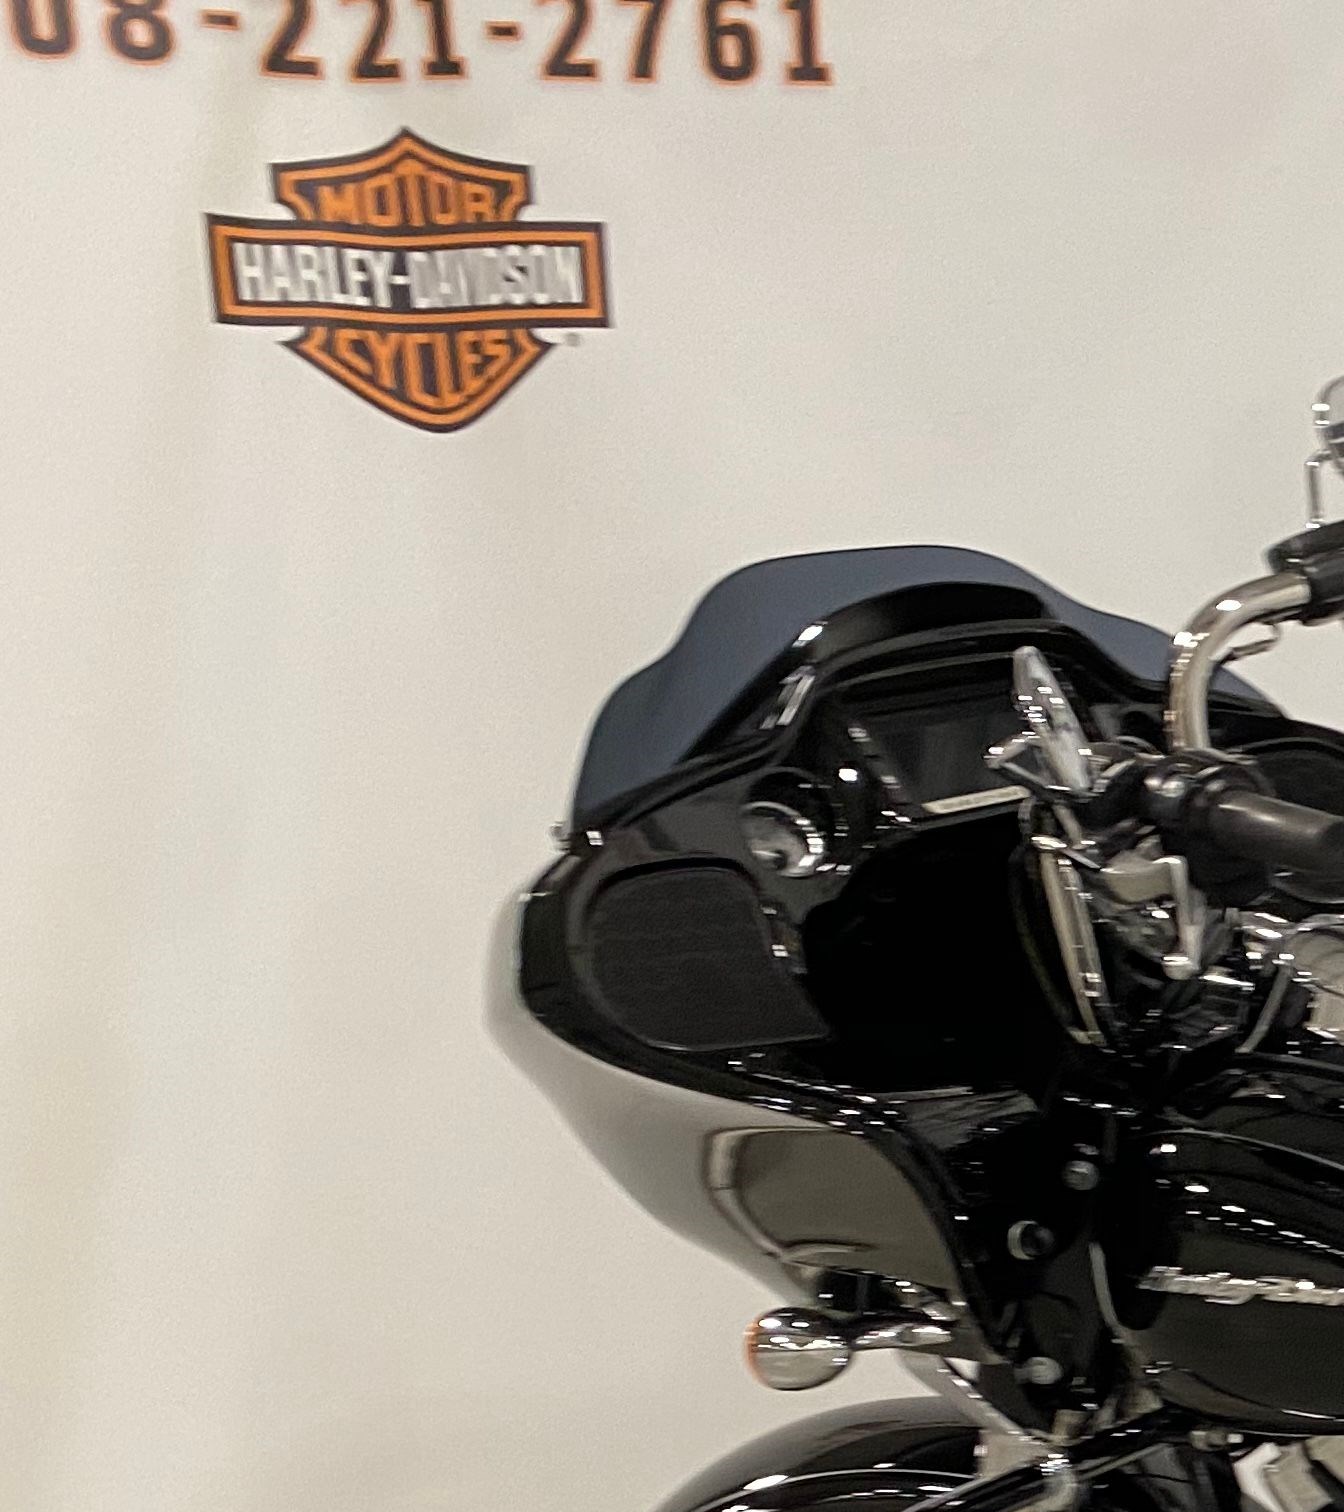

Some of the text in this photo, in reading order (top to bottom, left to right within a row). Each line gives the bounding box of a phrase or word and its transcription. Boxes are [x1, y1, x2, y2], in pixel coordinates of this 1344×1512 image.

[316, 164, 498, 227] MOTOR
[233, 241, 583, 309] HARLEY-DAVIDSON
[335, 329, 511, 403] CYCLES
